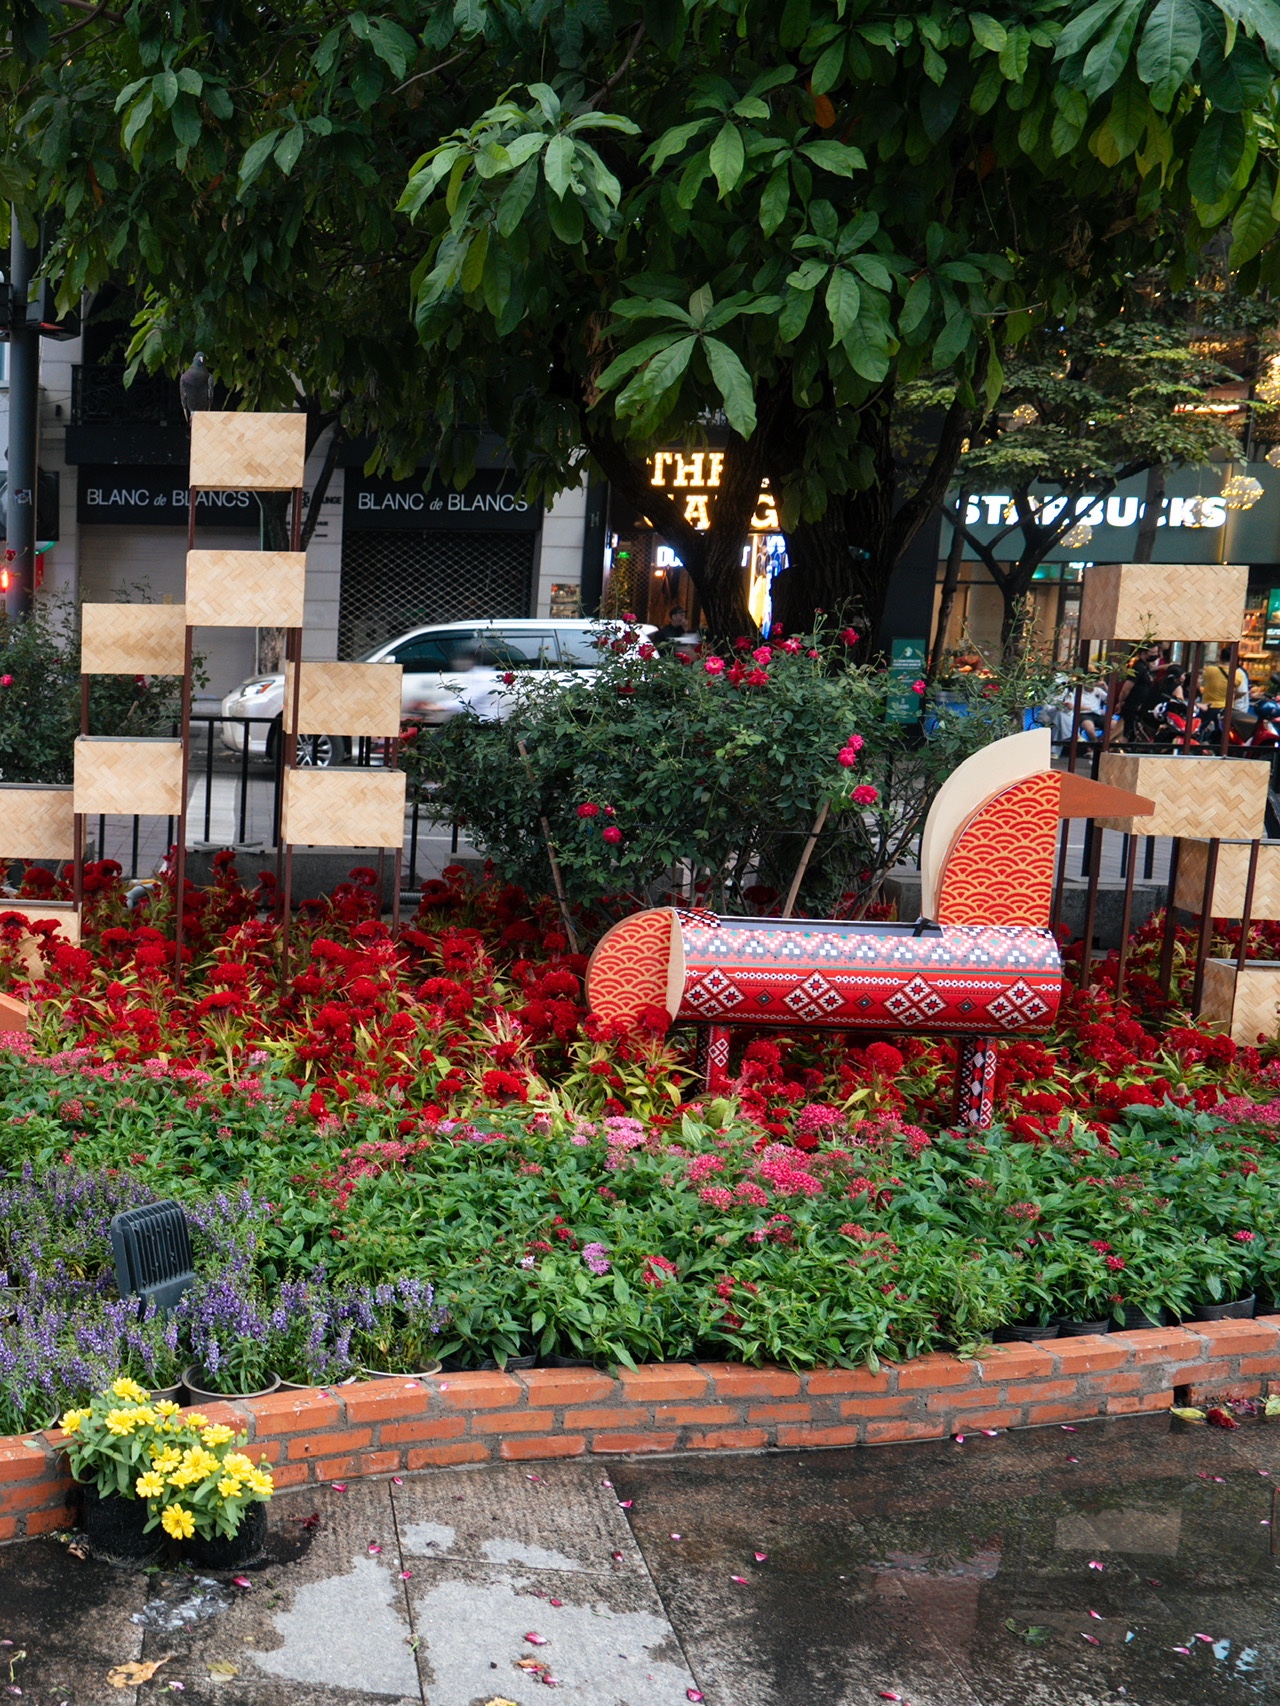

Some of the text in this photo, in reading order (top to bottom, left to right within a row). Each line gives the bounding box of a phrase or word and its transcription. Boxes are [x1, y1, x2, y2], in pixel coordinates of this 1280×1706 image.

[87, 489, 249, 507] BLANC de BLANCS
[358, 492, 528, 512] BLANC de BLANCS
